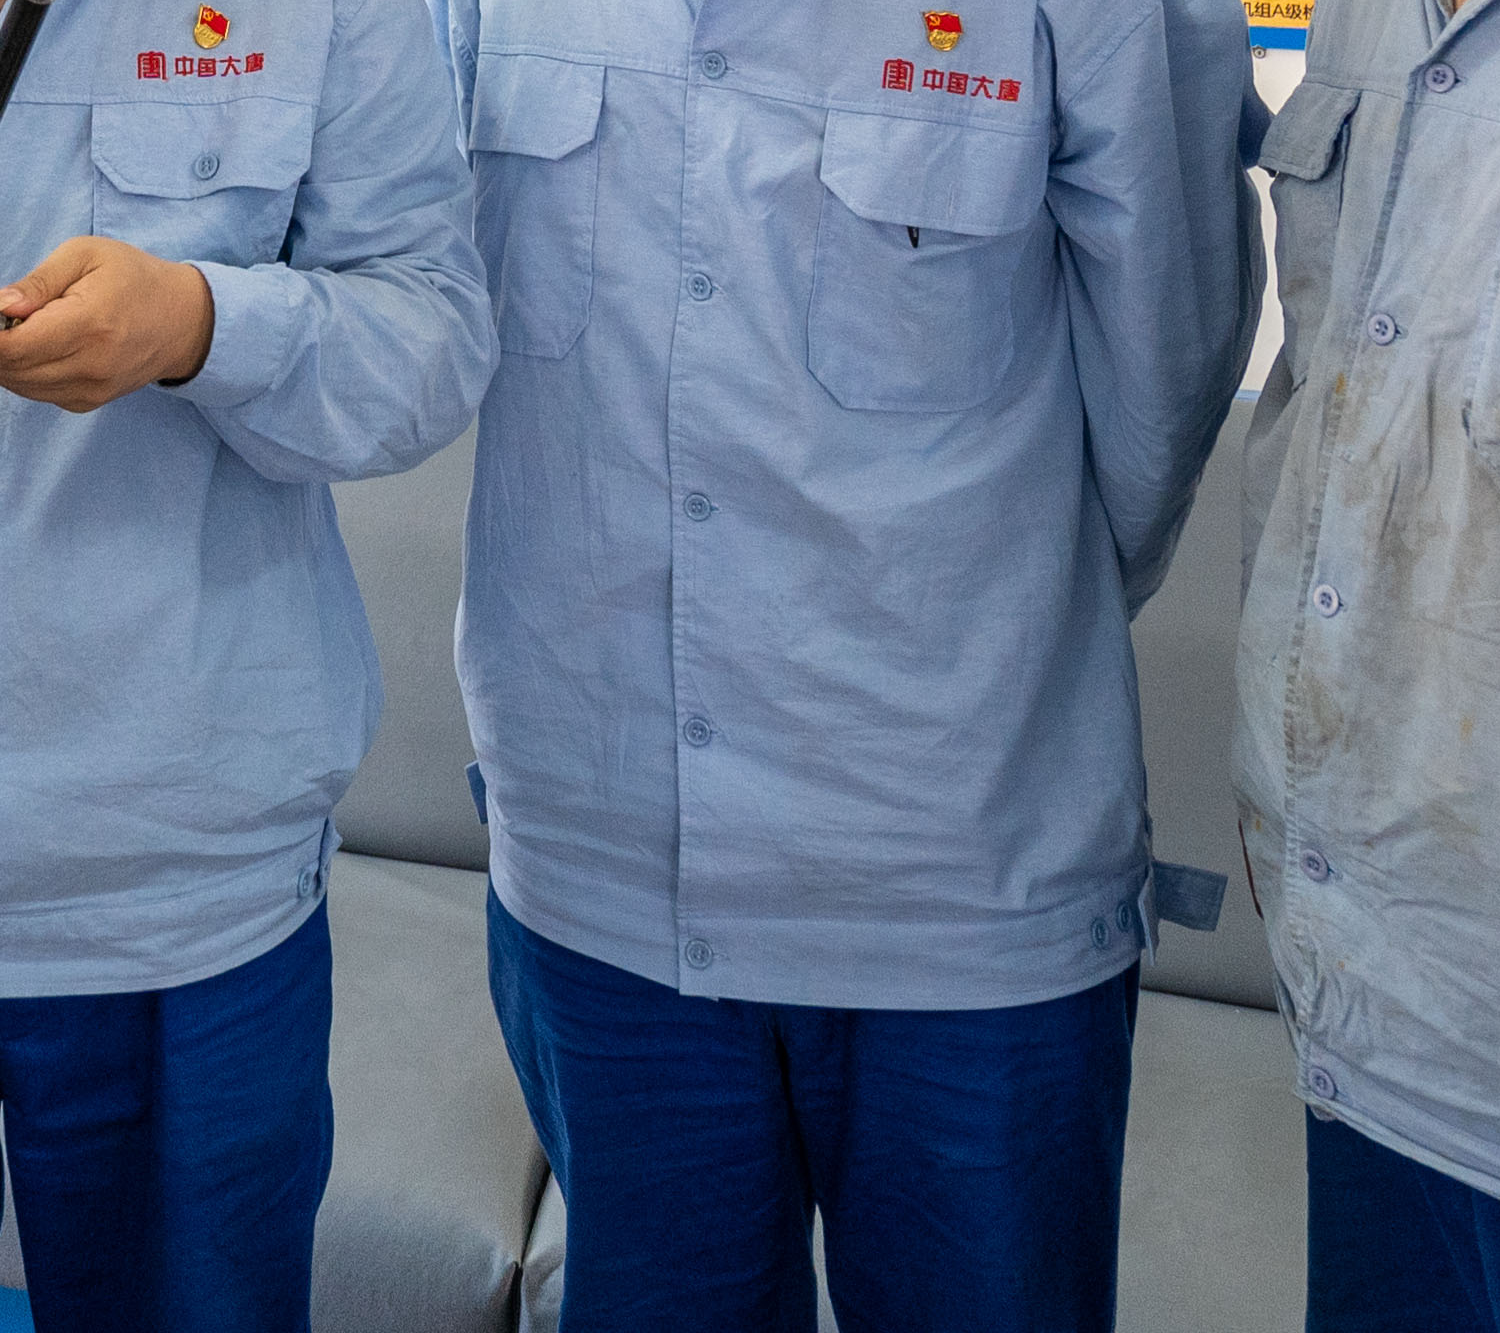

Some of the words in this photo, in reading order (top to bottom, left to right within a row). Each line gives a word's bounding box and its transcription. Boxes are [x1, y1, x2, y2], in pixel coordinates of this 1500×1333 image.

[175, 52, 264, 78] 中国大唐
[922, 68, 1023, 103] 中国大唐
